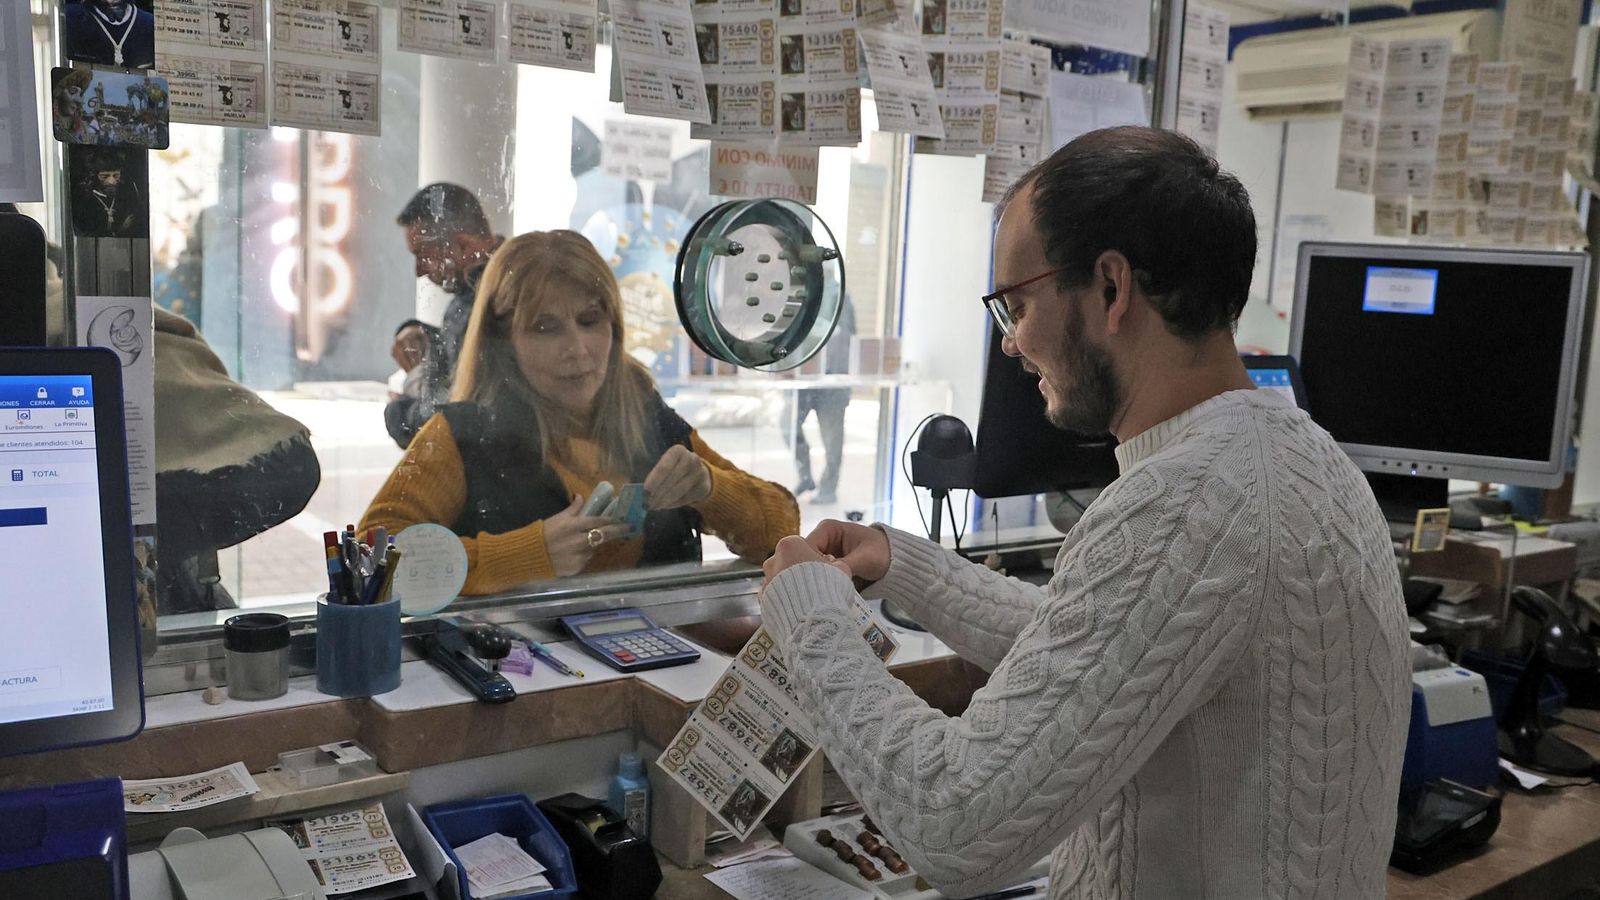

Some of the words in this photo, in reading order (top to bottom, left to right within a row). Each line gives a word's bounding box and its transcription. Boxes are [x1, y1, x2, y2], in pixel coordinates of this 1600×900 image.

[243, 26, 250, 36] 2
[721, 24, 758, 35] 75460
[363, 34, 369, 43] 2
[721, 85, 759, 96] 75460
[246, 99, 252, 108] 2
[363, 103, 369, 111] 2
[6, 440, 33, 448] clientes
[34, 439, 69, 447] atendidos:
[32, 470, 60, 478] TOTAL
[717, 715, 759, 753] 13687
[678, 766, 719, 806] 13687
[308, 812, 360, 827] 51965
[321, 852, 377, 867] 51965
